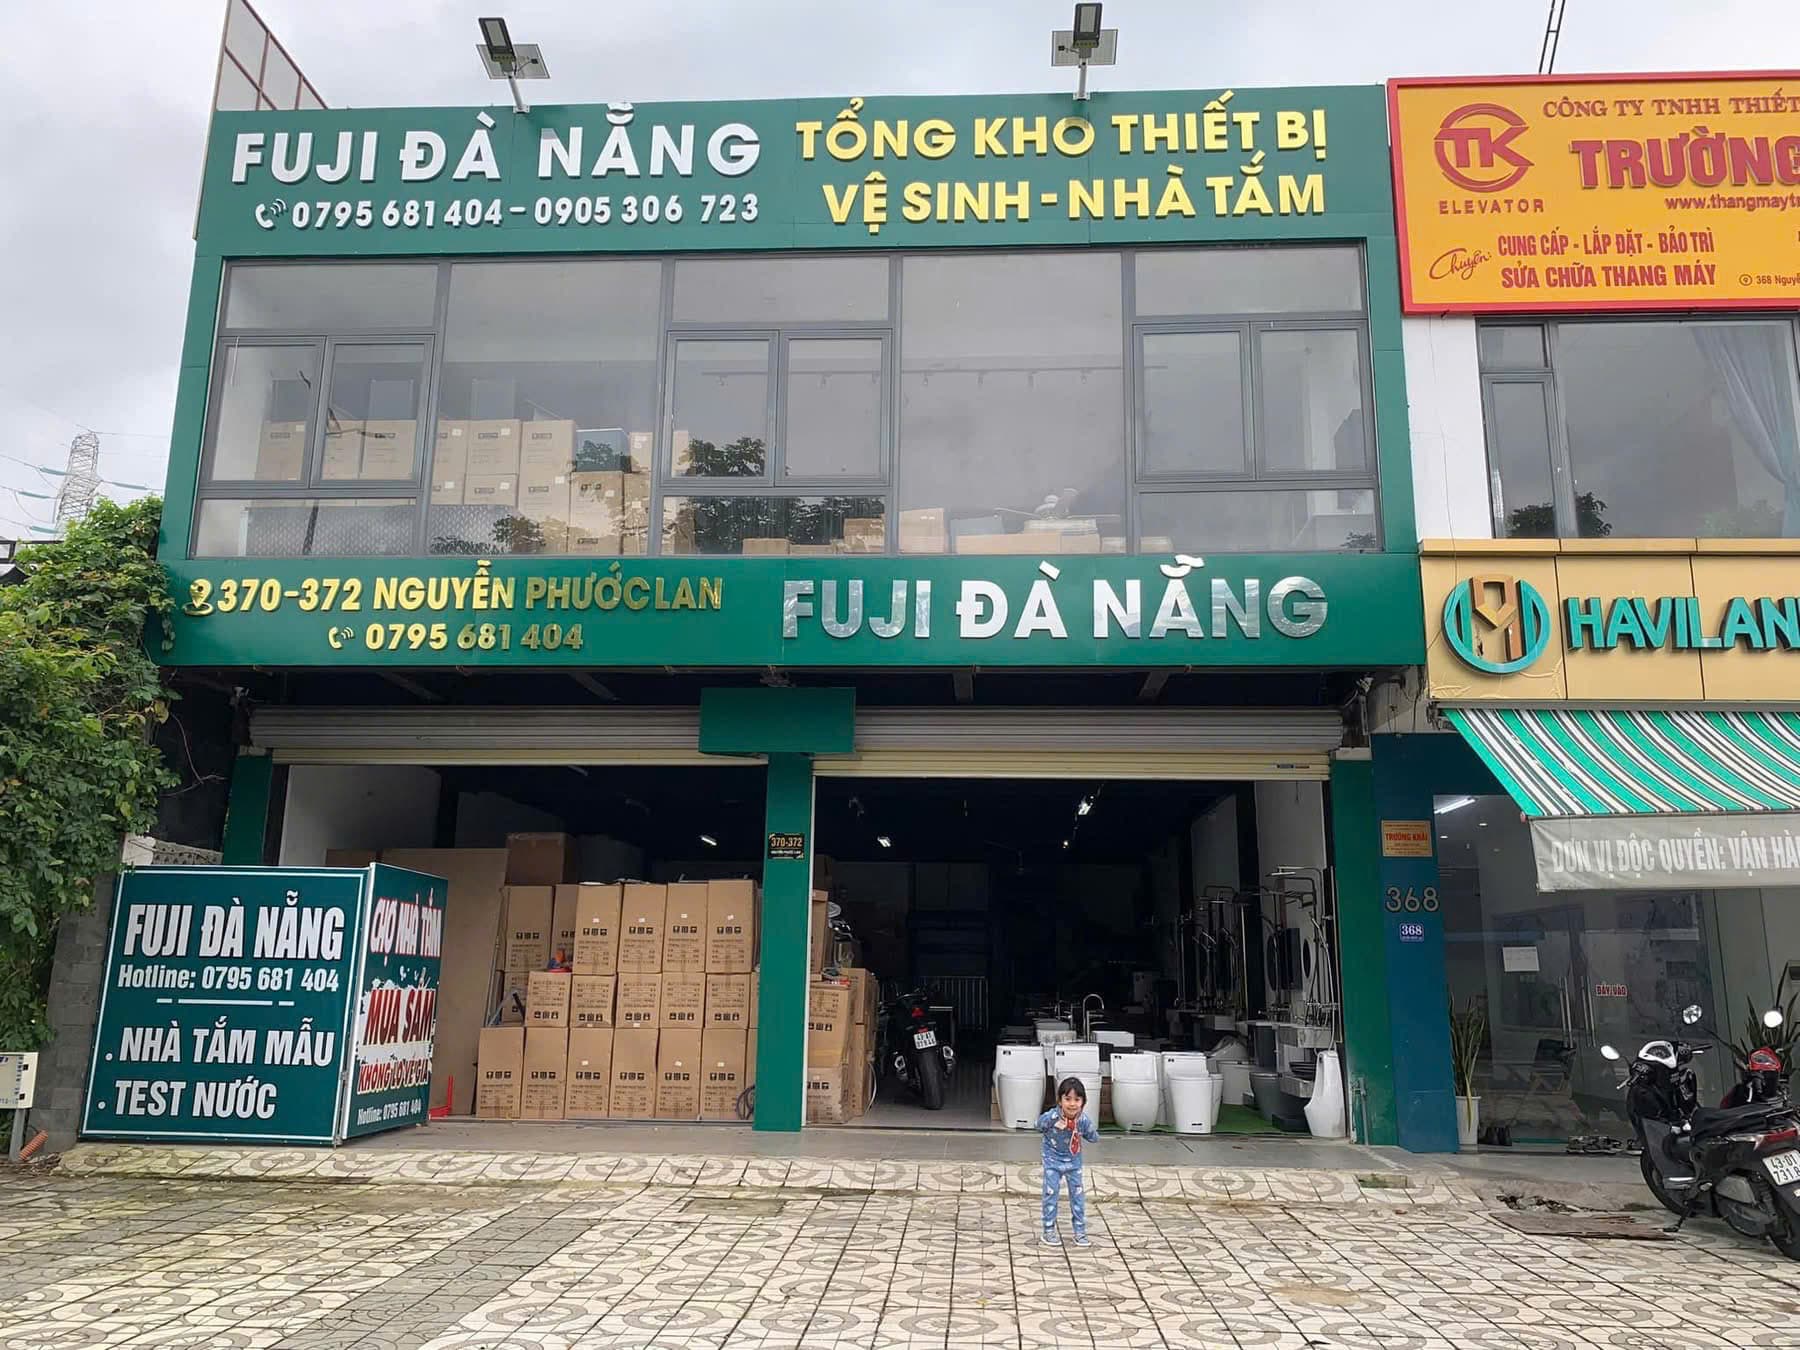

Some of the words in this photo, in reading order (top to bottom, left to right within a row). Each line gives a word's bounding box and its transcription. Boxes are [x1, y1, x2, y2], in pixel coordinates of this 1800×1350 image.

[1543, 96, 1608, 118] CÔNG
[1615, 100, 1644, 117] TY
[1655, 98, 1721, 116] TNHH
[1729, 88, 1800, 114] THIẾT
[231, 131, 379, 184] FUJI
[399, 111, 502, 182] ĐÀ
[537, 102, 760, 179] NẴNG
[795, 98, 957, 161] TỔNG
[973, 116, 1096, 158] KHO
[1111, 90, 1261, 154] THIẾT
[1275, 109, 1327, 160] BỊ
[1569, 126, 1800, 188] TRƯỜNG
[292, 199, 373, 229] 0795
[381, 199, 435, 228] 681
[443, 198, 502, 227] 404
[534, 196, 612, 226] 0905
[621, 195, 683, 224] 306
[700, 194, 759, 223] 723
[823, 170, 888, 234] VỆ
[901, 180, 1031, 224] SINH
[1068, 165, 1197, 219] NHÀ
[1205, 151, 1327, 217] TẮM
[1439, 199, 1545, 215] ELEVATOR
[1497, 234, 1537, 256] CUNG
[1540, 226, 1569, 256] CẤP
[1583, 225, 1611, 255] LẮP
[1615, 228, 1643, 257] ĐẶT
[1658, 225, 1687, 253] BẢO
[1689, 227, 1715, 253] TRÌ
[1429, 248, 1493, 280] Chuyên:
[1501, 260, 1540, 288] SỬA
[1545, 262, 1597, 288] CHỮA
[1601, 265, 1667, 287] THANG
[1673, 259, 1716, 286] MÁY
[1756, 275, 1773, 285] 368
[216, 578, 362, 613] 370-372
[373, 560, 514, 611] NGUYỄN
[655, 576, 723, 610] LAN
[782, 579, 932, 639] FUJI
[956, 560, 1068, 639] ĐÀ
[1094, 555, 1329, 639] NẴNG
[365, 623, 448, 650] 0795
[457, 623, 511, 650] 681
[520, 624, 584, 650] 404
[1566, 596, 1800, 649] HAVILAN
[770, 837, 803, 847] 370-372
[1551, 838, 1592, 873] ĐƠN
[1593, 840, 1614, 879] VỊ
[1617, 832, 1655, 878] ĐỘC
[1658, 828, 1726, 874] QUYỀN:
[1727, 830, 1768, 877] VẬN
[1386, 886, 1440, 912] 368
[122, 904, 193, 957] FUJI
[198, 897, 244, 958] ĐÀ
[253, 890, 345, 961] NẴNG
[1401, 925, 1422, 936] 368
[117, 964, 196, 990] Hotline:
[201, 966, 252, 991] 0795
[257, 967, 293, 992] 681
[301, 968, 339, 992] 404
[364, 989, 401, 1045] MUA
[402, 967, 435, 1043] SẮM
[119, 1020, 181, 1062] NHÀ
[192, 1015, 256, 1065] TẮM
[264, 1017, 335, 1067] MẪU
[115, 1080, 186, 1116] TEST
[194, 1075, 278, 1119] NƯỚC
